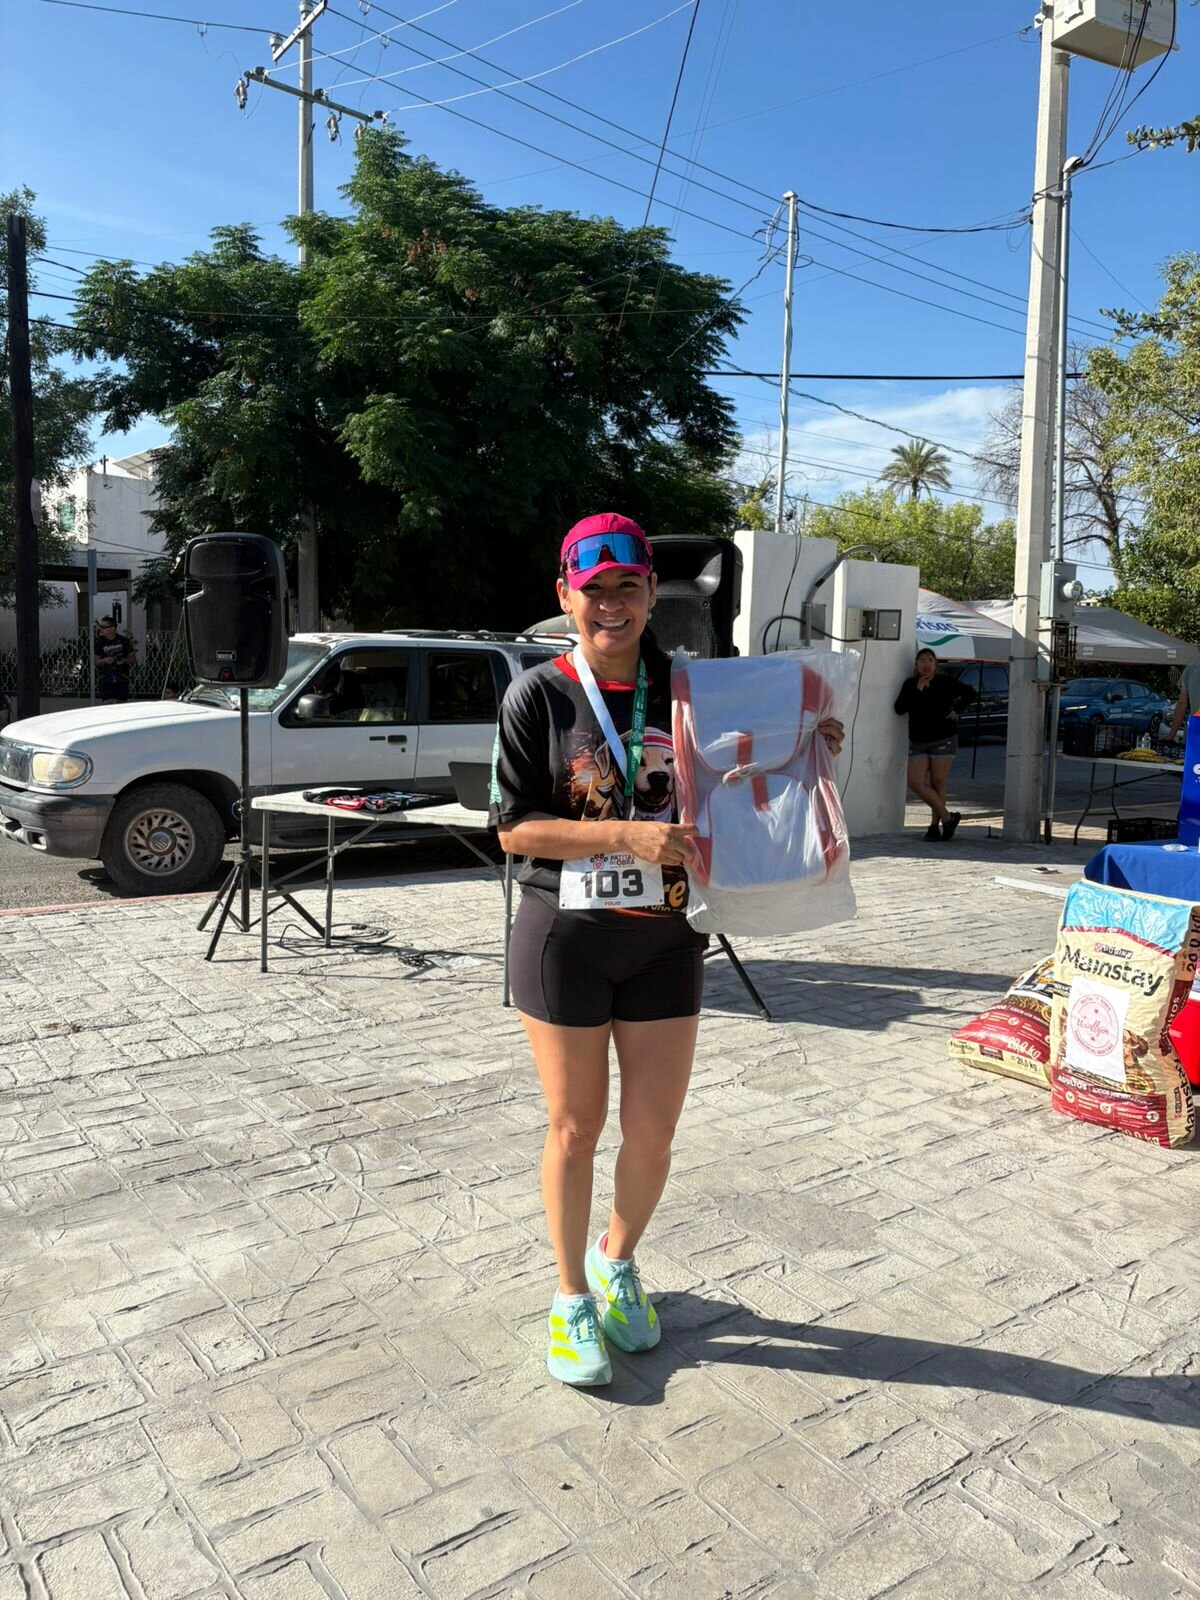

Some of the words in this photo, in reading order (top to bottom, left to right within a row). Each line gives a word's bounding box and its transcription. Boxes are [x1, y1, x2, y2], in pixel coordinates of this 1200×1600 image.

[580, 868, 644, 898] 103
[1060, 944, 1164, 997] Mainstay
[1058, 1074, 1087, 1091] ADULTOS
